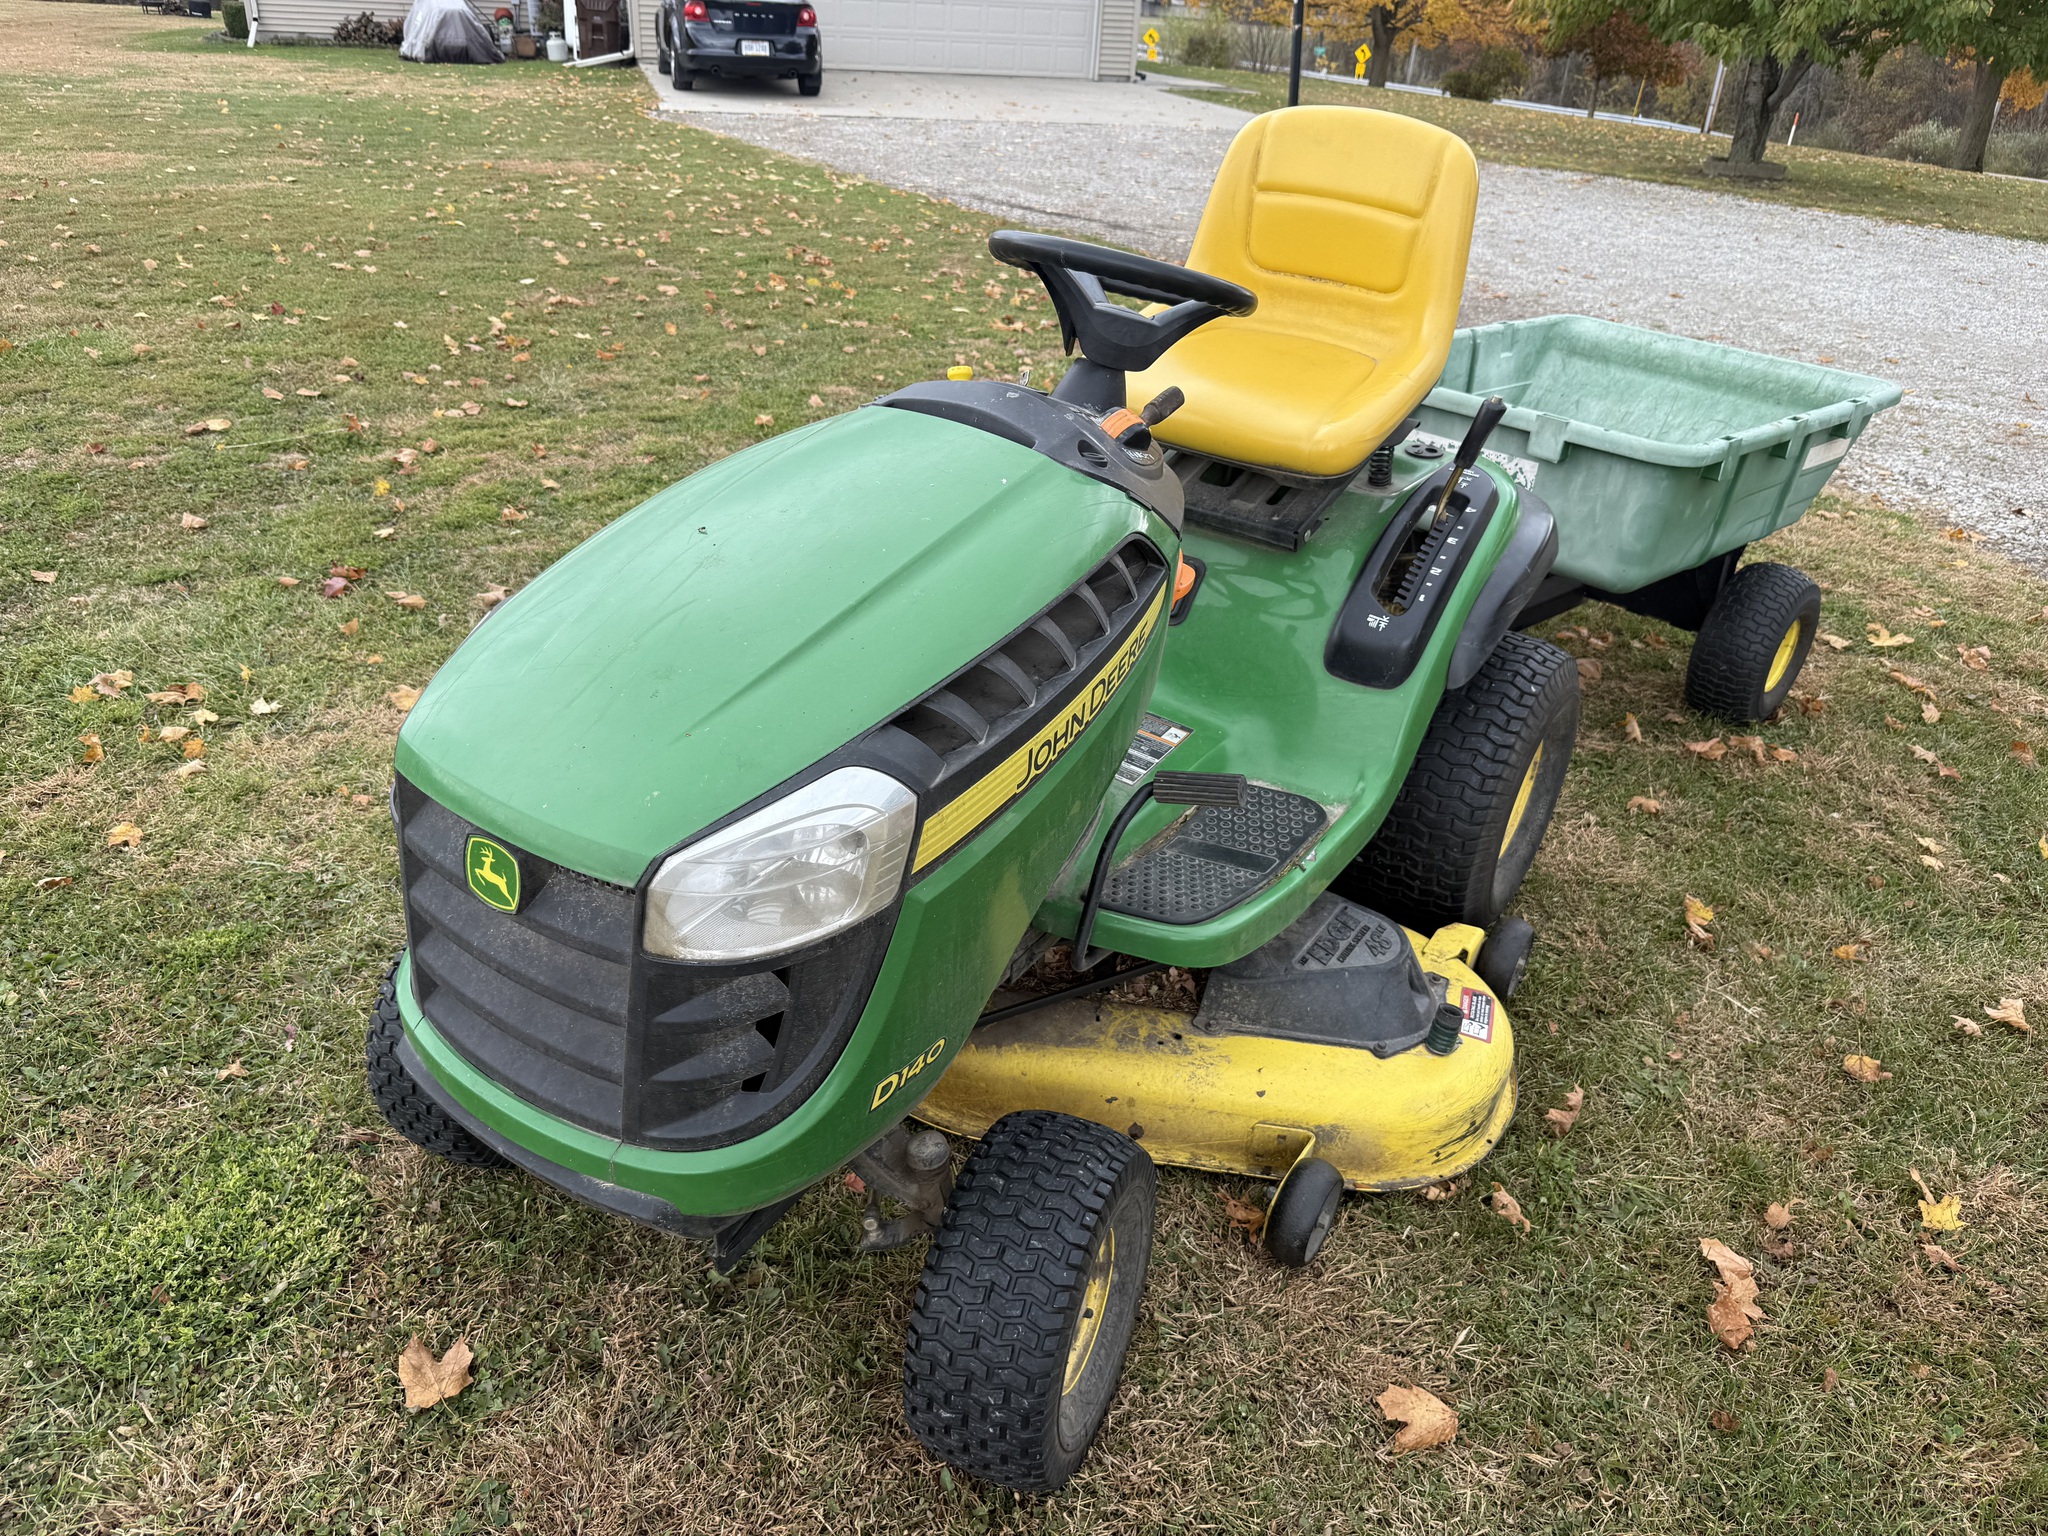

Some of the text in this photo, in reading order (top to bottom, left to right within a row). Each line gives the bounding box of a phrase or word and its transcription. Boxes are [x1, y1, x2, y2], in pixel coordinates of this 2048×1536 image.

[1016, 621, 1149, 790] JOHN DEERE
[1306, 910, 1362, 966] EDGE
[869, 1037, 946, 1112] D140
